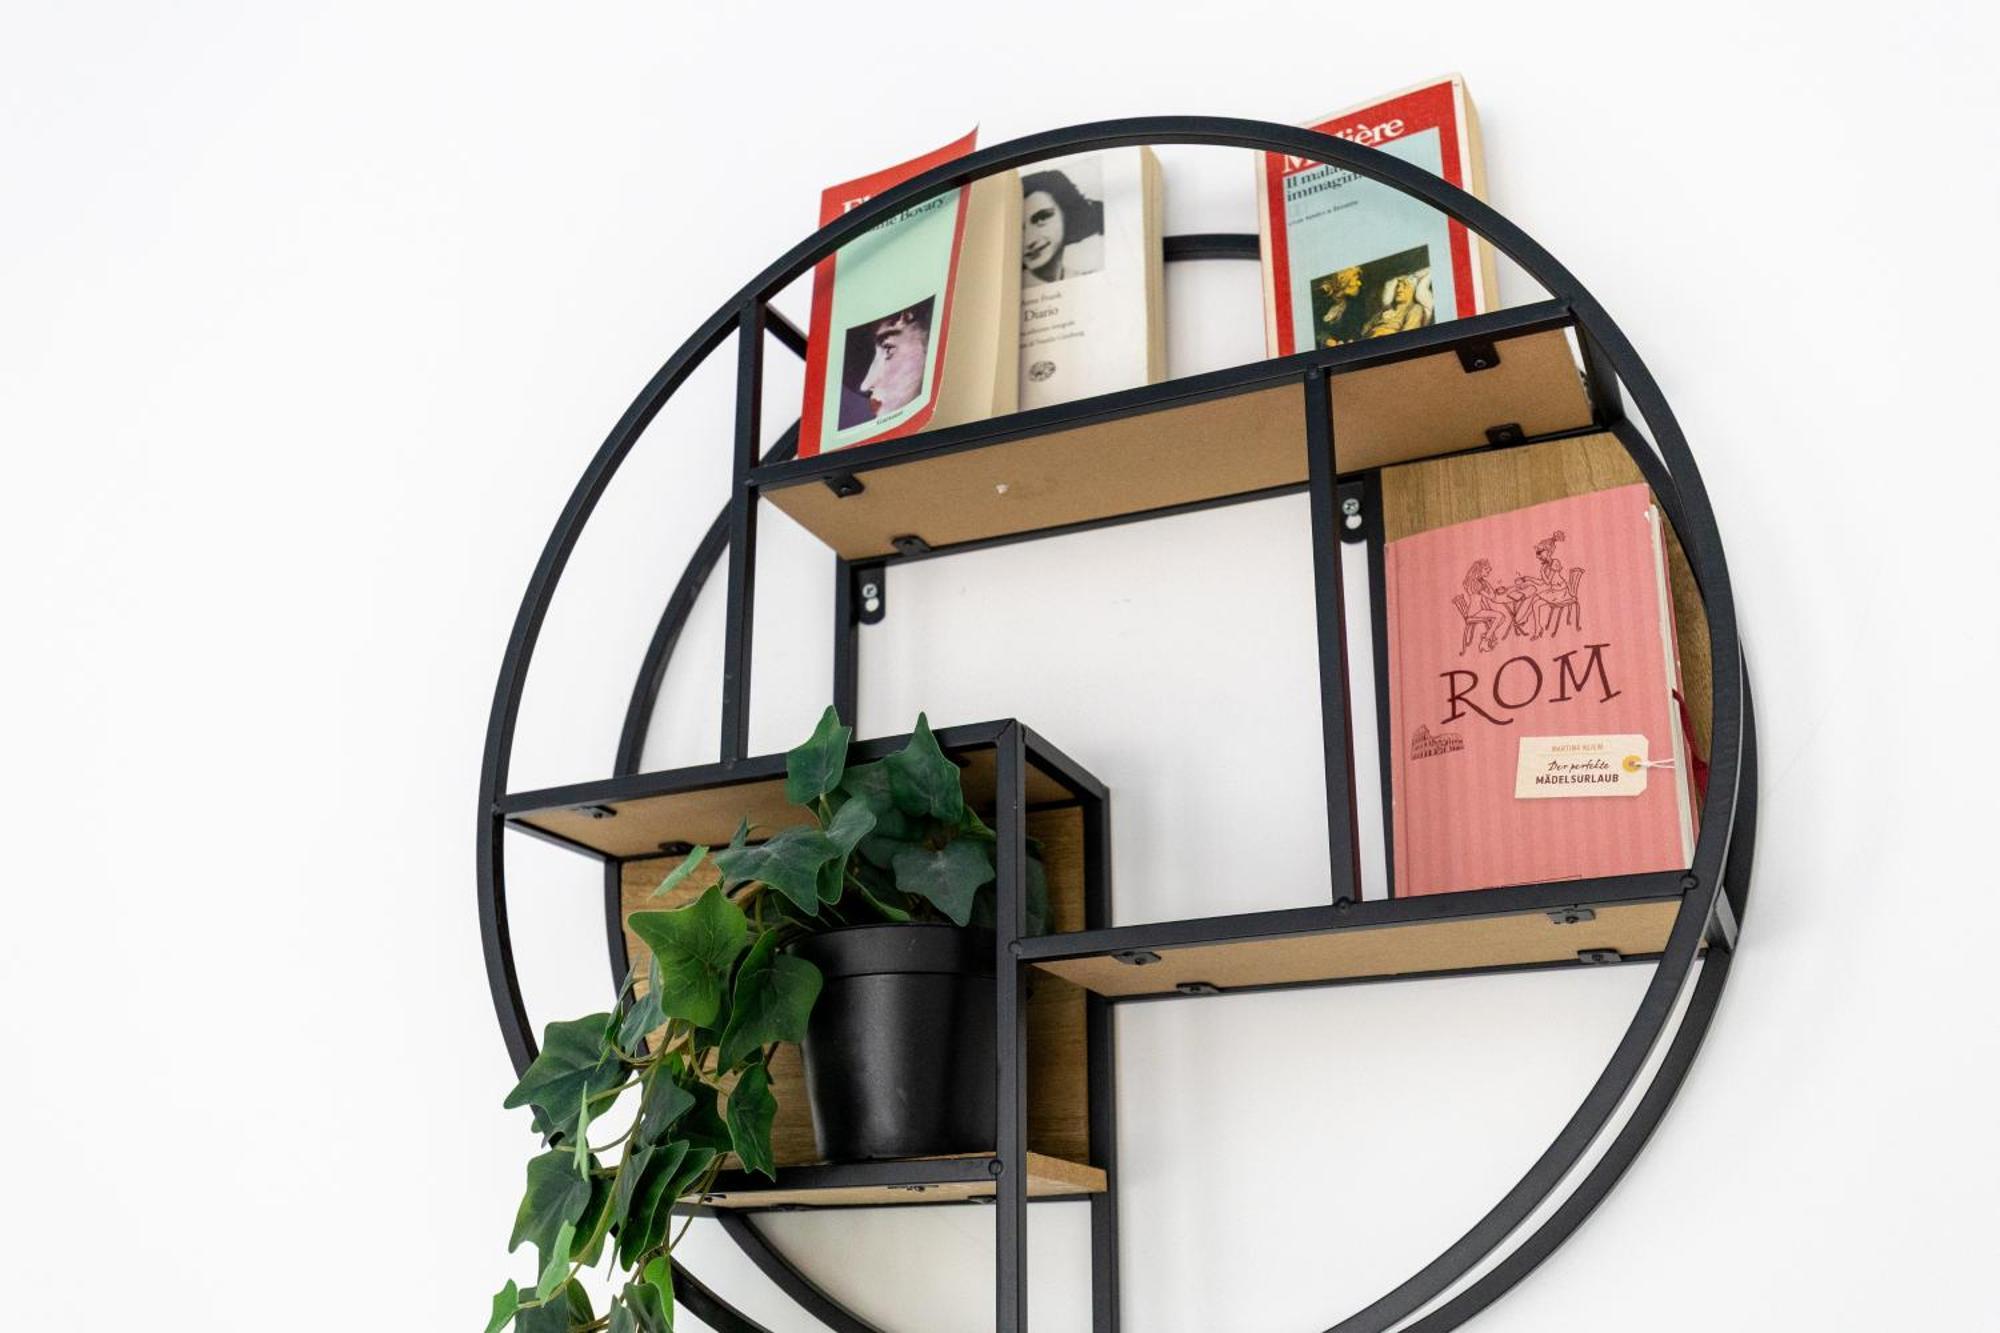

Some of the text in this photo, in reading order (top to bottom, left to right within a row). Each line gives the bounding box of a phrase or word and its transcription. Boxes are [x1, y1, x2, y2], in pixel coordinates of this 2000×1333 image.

[1282, 119, 1404, 174] Mière
[1287, 165, 1343, 189] Il mala
[1024, 306, 1059, 322] Diario
[1440, 643, 1622, 726] ROM
[1548, 759, 1611, 774] Der perfekte
[1536, 773, 1620, 785] MÄDELSURLAUB
